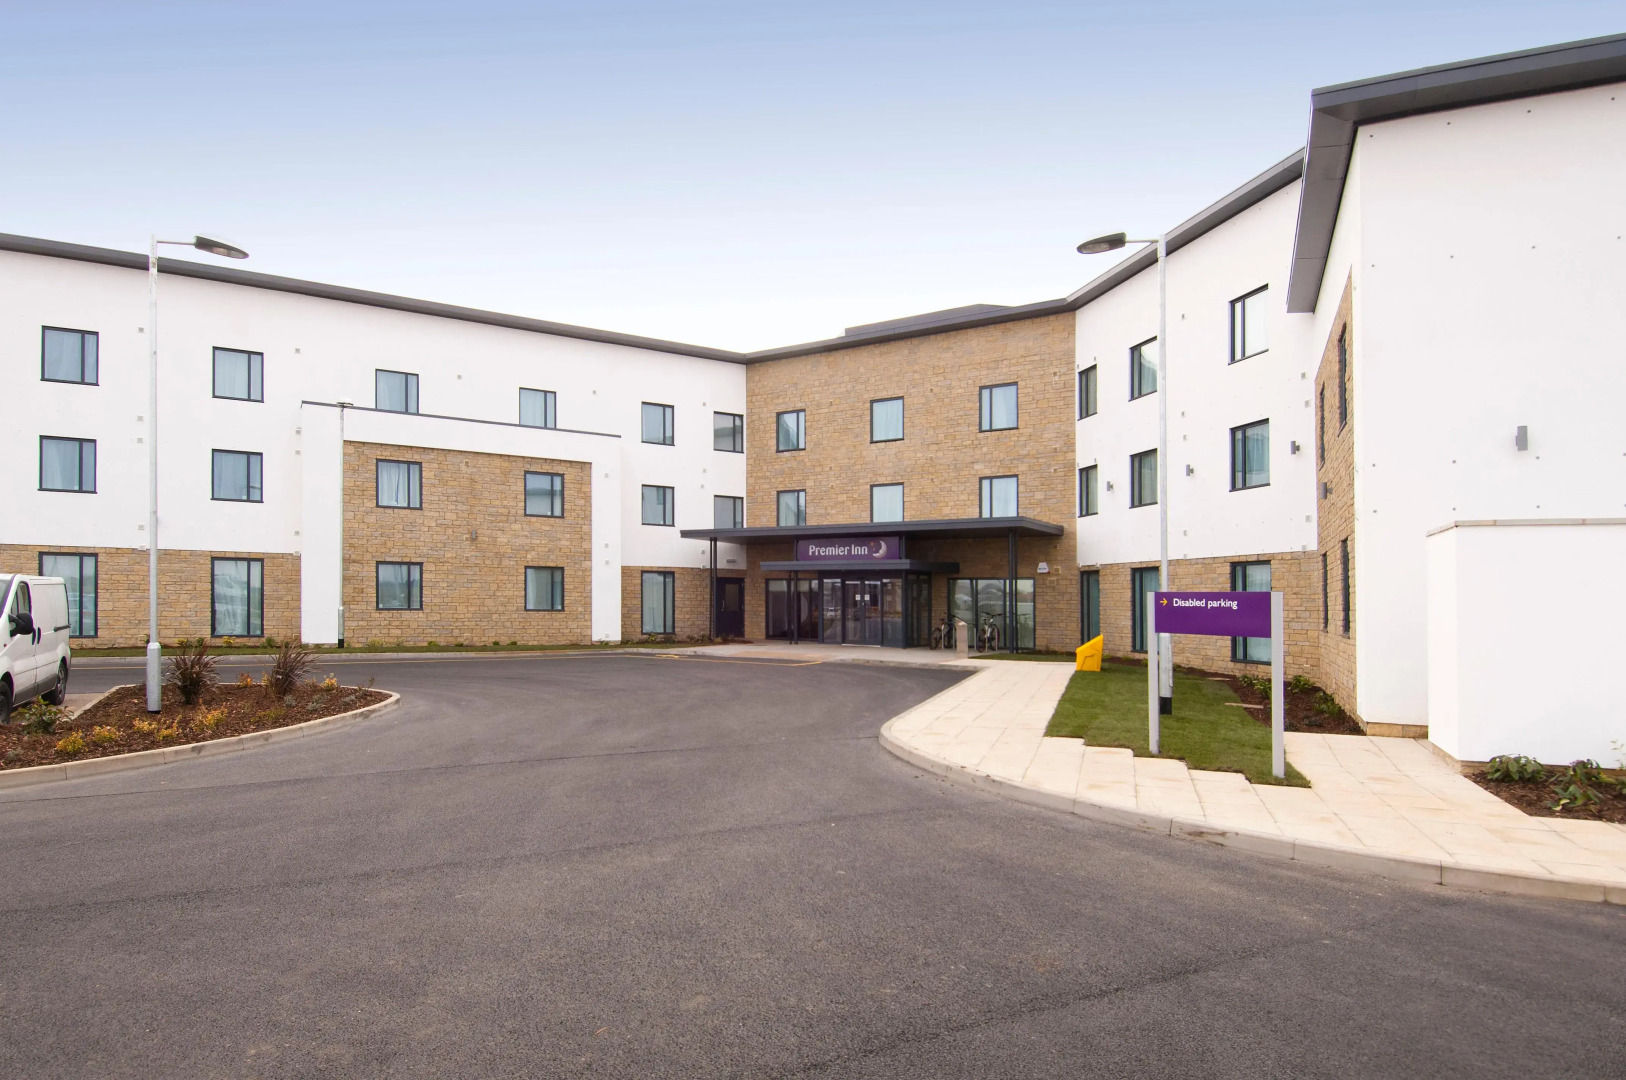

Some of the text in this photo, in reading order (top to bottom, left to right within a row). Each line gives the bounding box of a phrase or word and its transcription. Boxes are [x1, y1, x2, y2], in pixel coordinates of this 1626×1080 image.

[809, 544, 868, 556] Premier Inn
[1173, 598, 1238, 610] Disabled parking
